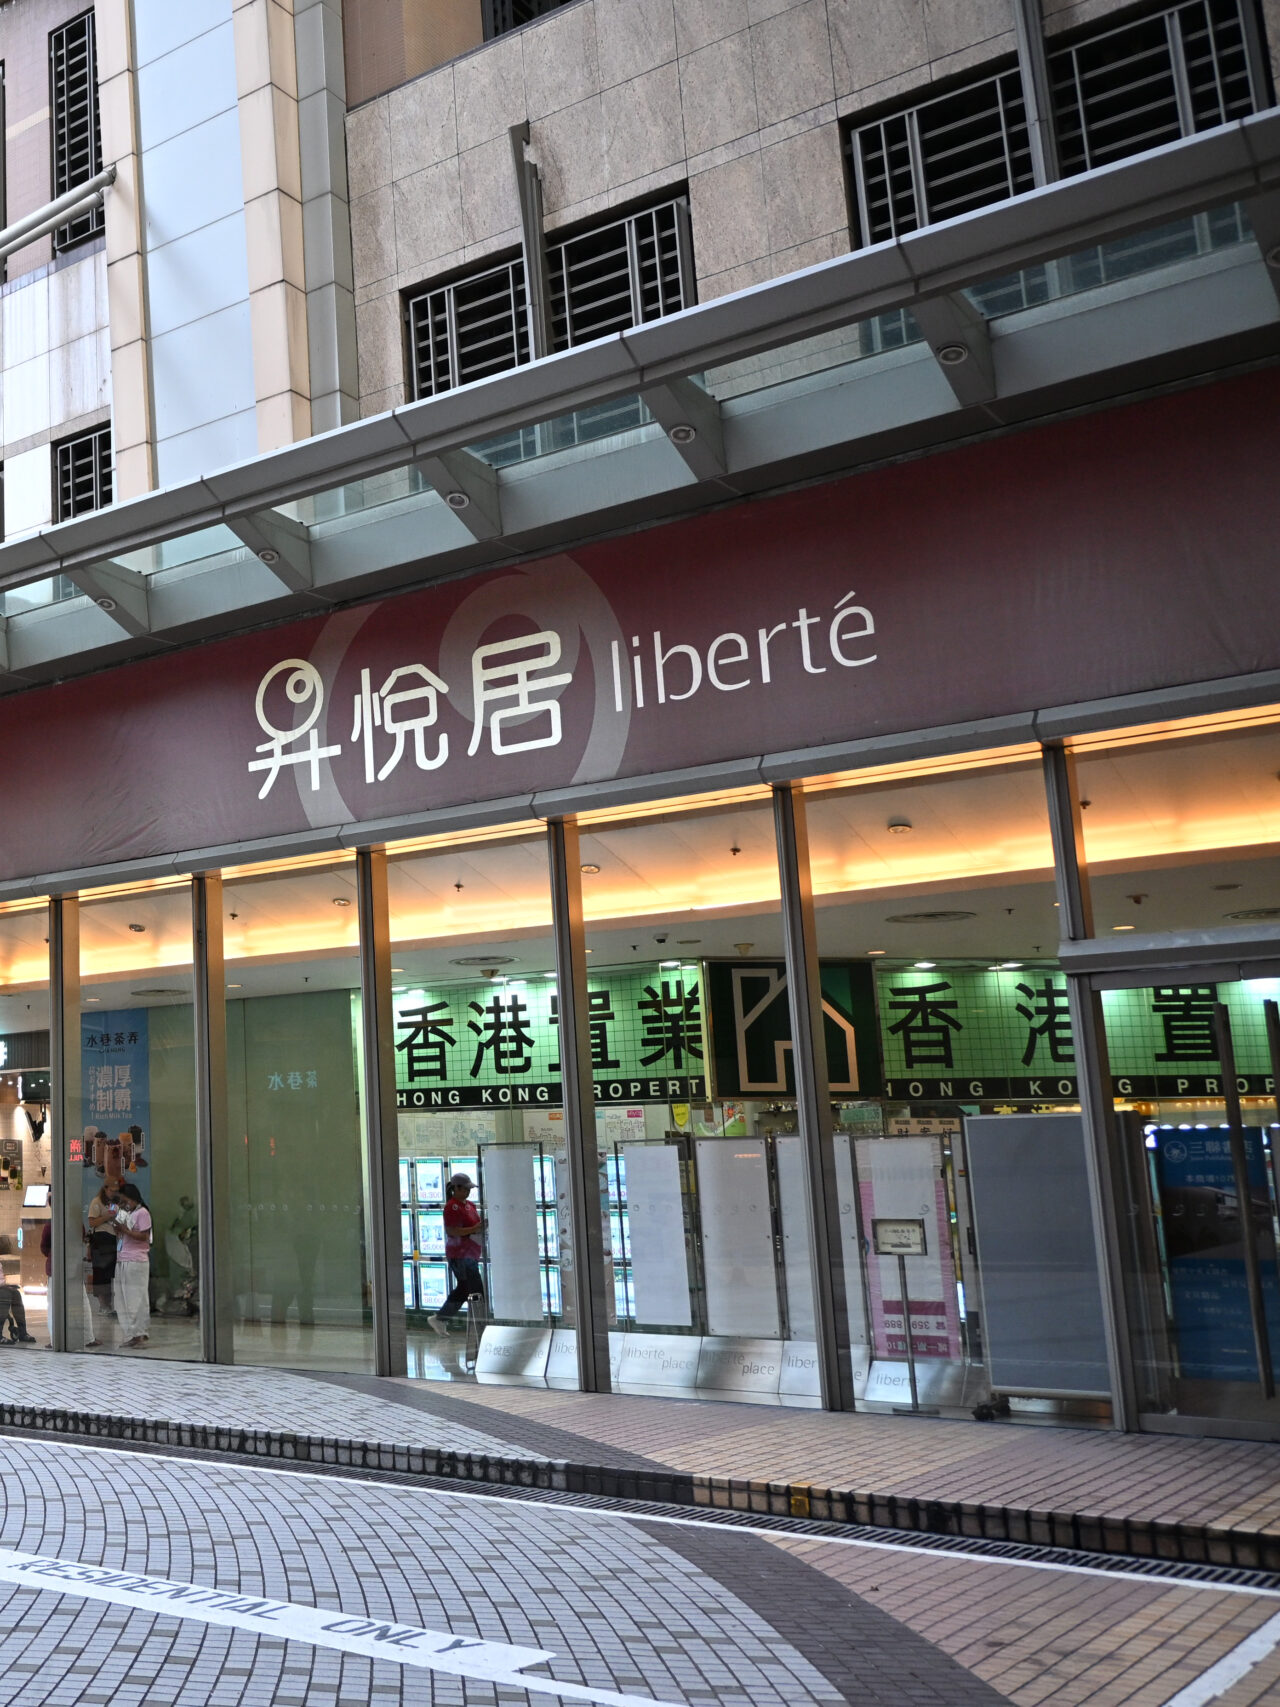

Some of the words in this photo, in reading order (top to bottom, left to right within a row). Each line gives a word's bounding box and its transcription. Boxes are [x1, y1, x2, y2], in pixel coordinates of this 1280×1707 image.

[610, 590, 878, 712] liberté
[396, 1090, 460, 1106] HONG
[481, 1086, 549, 1103] KONG
[593, 1078, 699, 1099] ROPERT
[1029, 1078, 1133, 1097] KOG
[741, 1361, 776, 1377] place
[6, 1558, 280, 1622] RESIDENTIAL
[320, 1618, 485, 1655] ONLY
